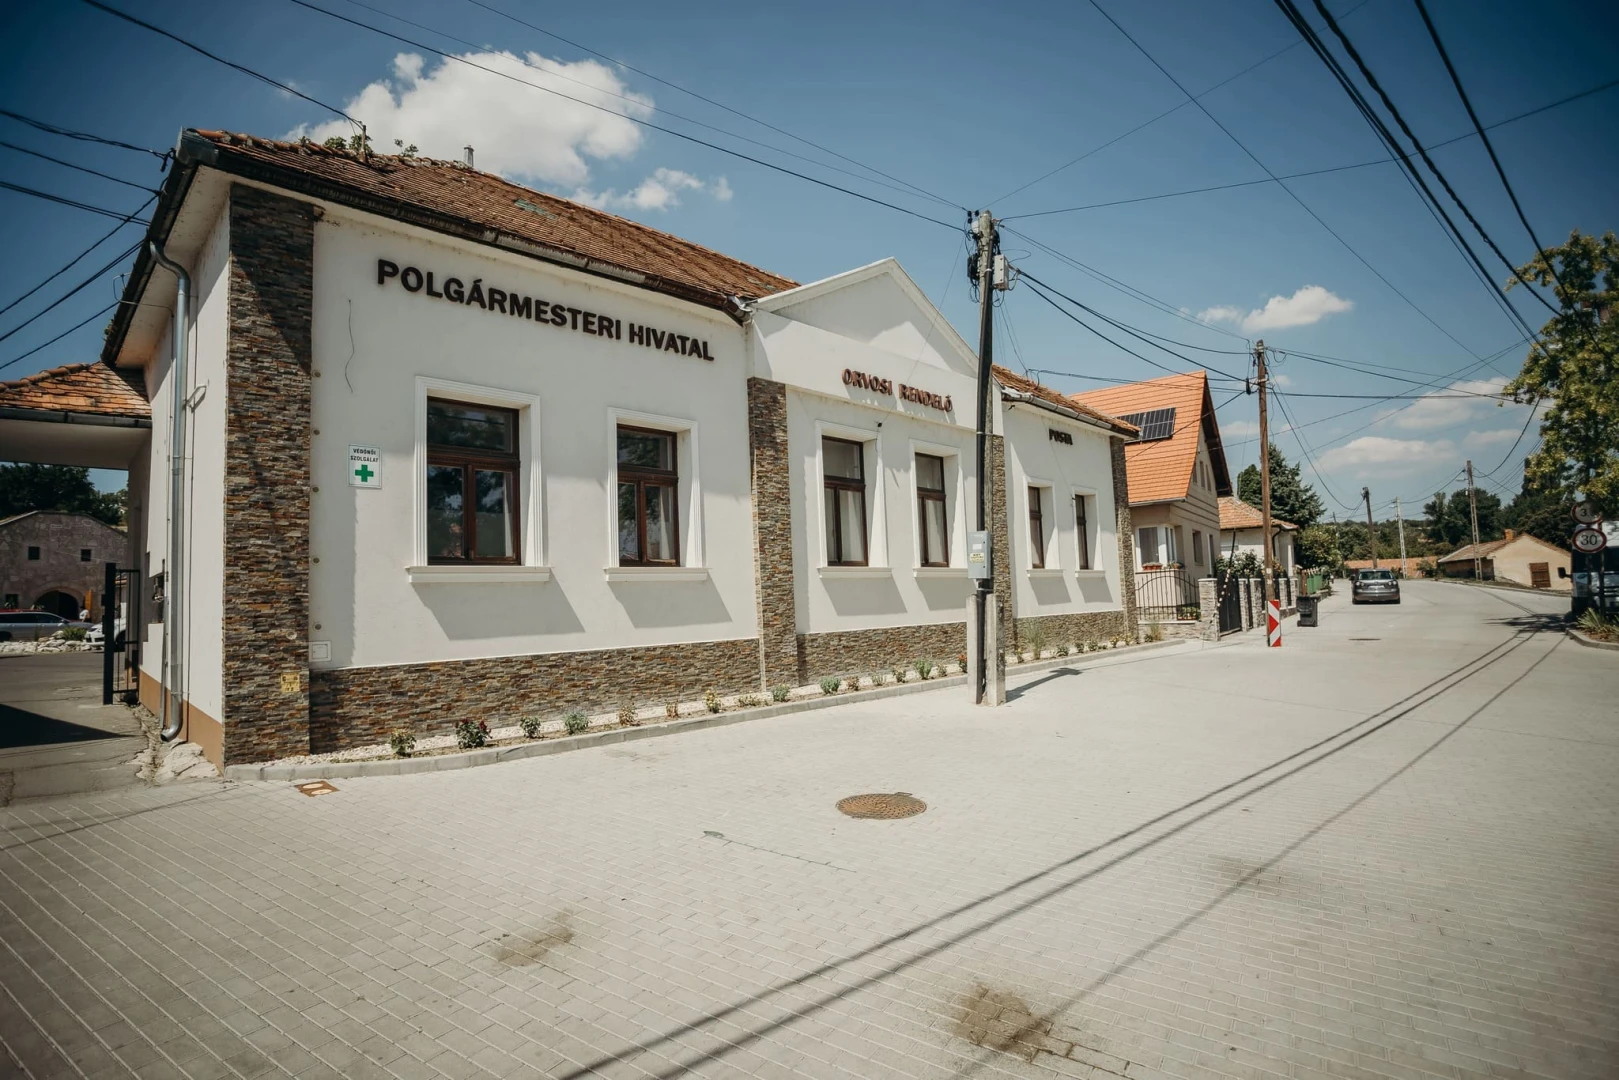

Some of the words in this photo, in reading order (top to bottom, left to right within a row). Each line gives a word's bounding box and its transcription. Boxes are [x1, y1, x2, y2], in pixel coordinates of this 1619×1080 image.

[377, 258, 622, 341] POLGÁRMESTERI
[628, 322, 715, 362] HIVATAL
[842, 368, 893, 396] ORVOSI
[1048, 428, 1073, 446] POSTA
[1580, 534, 1598, 546] 30
